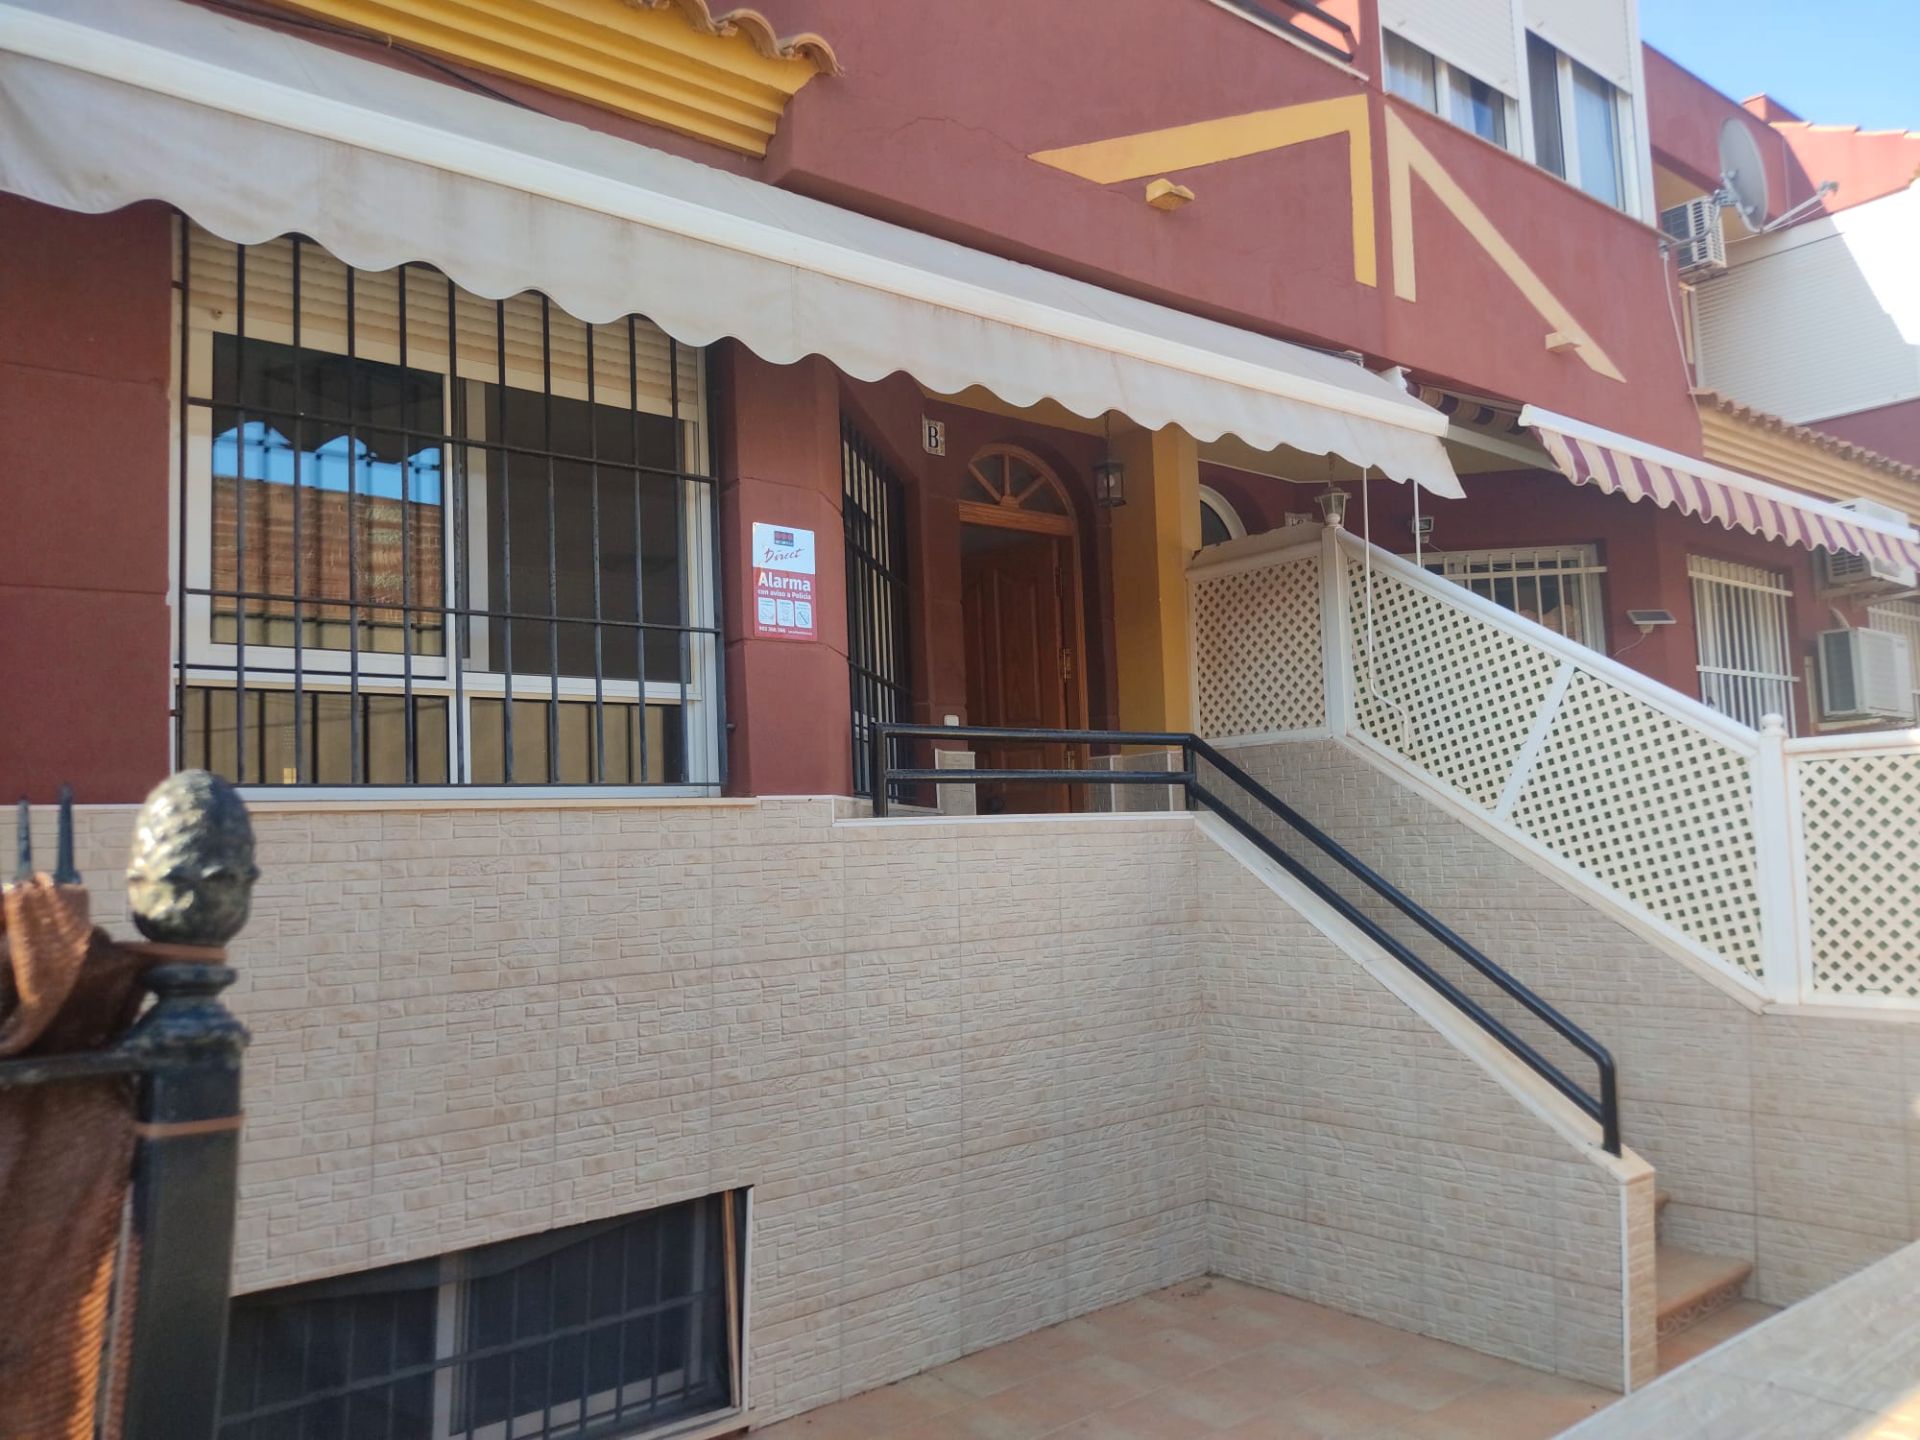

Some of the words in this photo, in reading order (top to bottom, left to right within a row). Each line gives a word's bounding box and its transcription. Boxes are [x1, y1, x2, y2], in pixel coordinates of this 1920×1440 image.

[928, 425, 939, 449] B
[764, 548, 806, 563] Direct
[758, 572, 811, 592] Alarma
